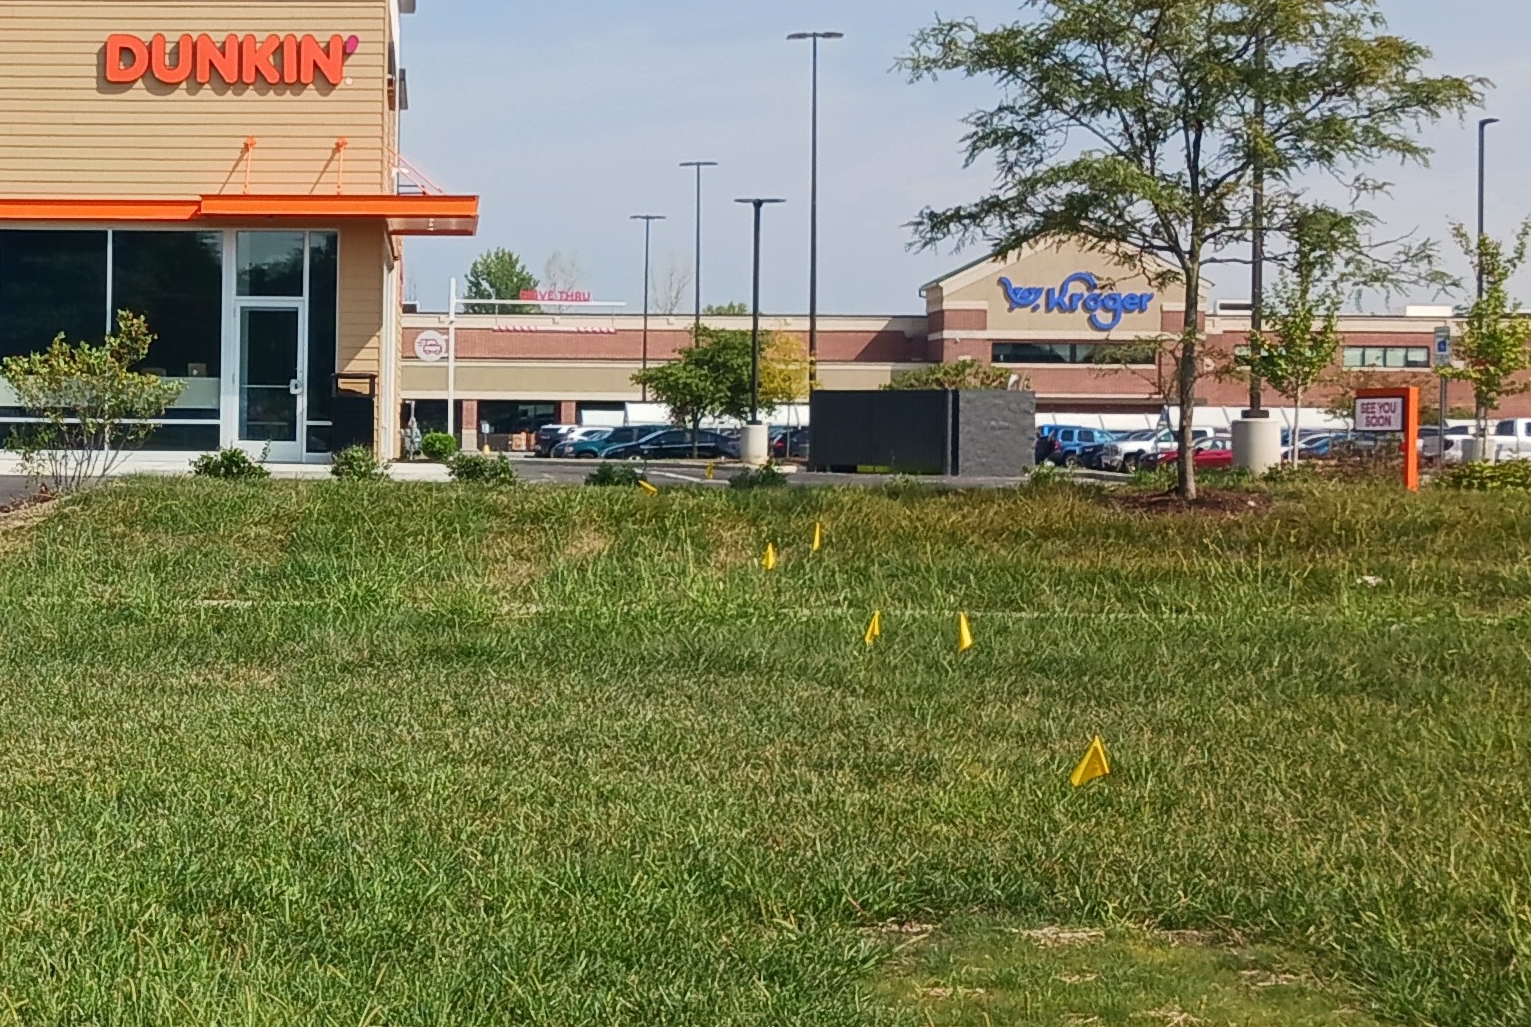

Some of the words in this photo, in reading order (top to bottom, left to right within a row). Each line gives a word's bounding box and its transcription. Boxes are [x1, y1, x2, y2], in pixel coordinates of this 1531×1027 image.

[105, 33, 359, 84] DUNKIN'
[558, 290, 590, 302] THRU
[1046, 272, 1154, 331] Kroger
[1361, 402, 1376, 414] SEE
[1377, 402, 1396, 413] YOU
[1365, 415, 1392, 427] SOON
